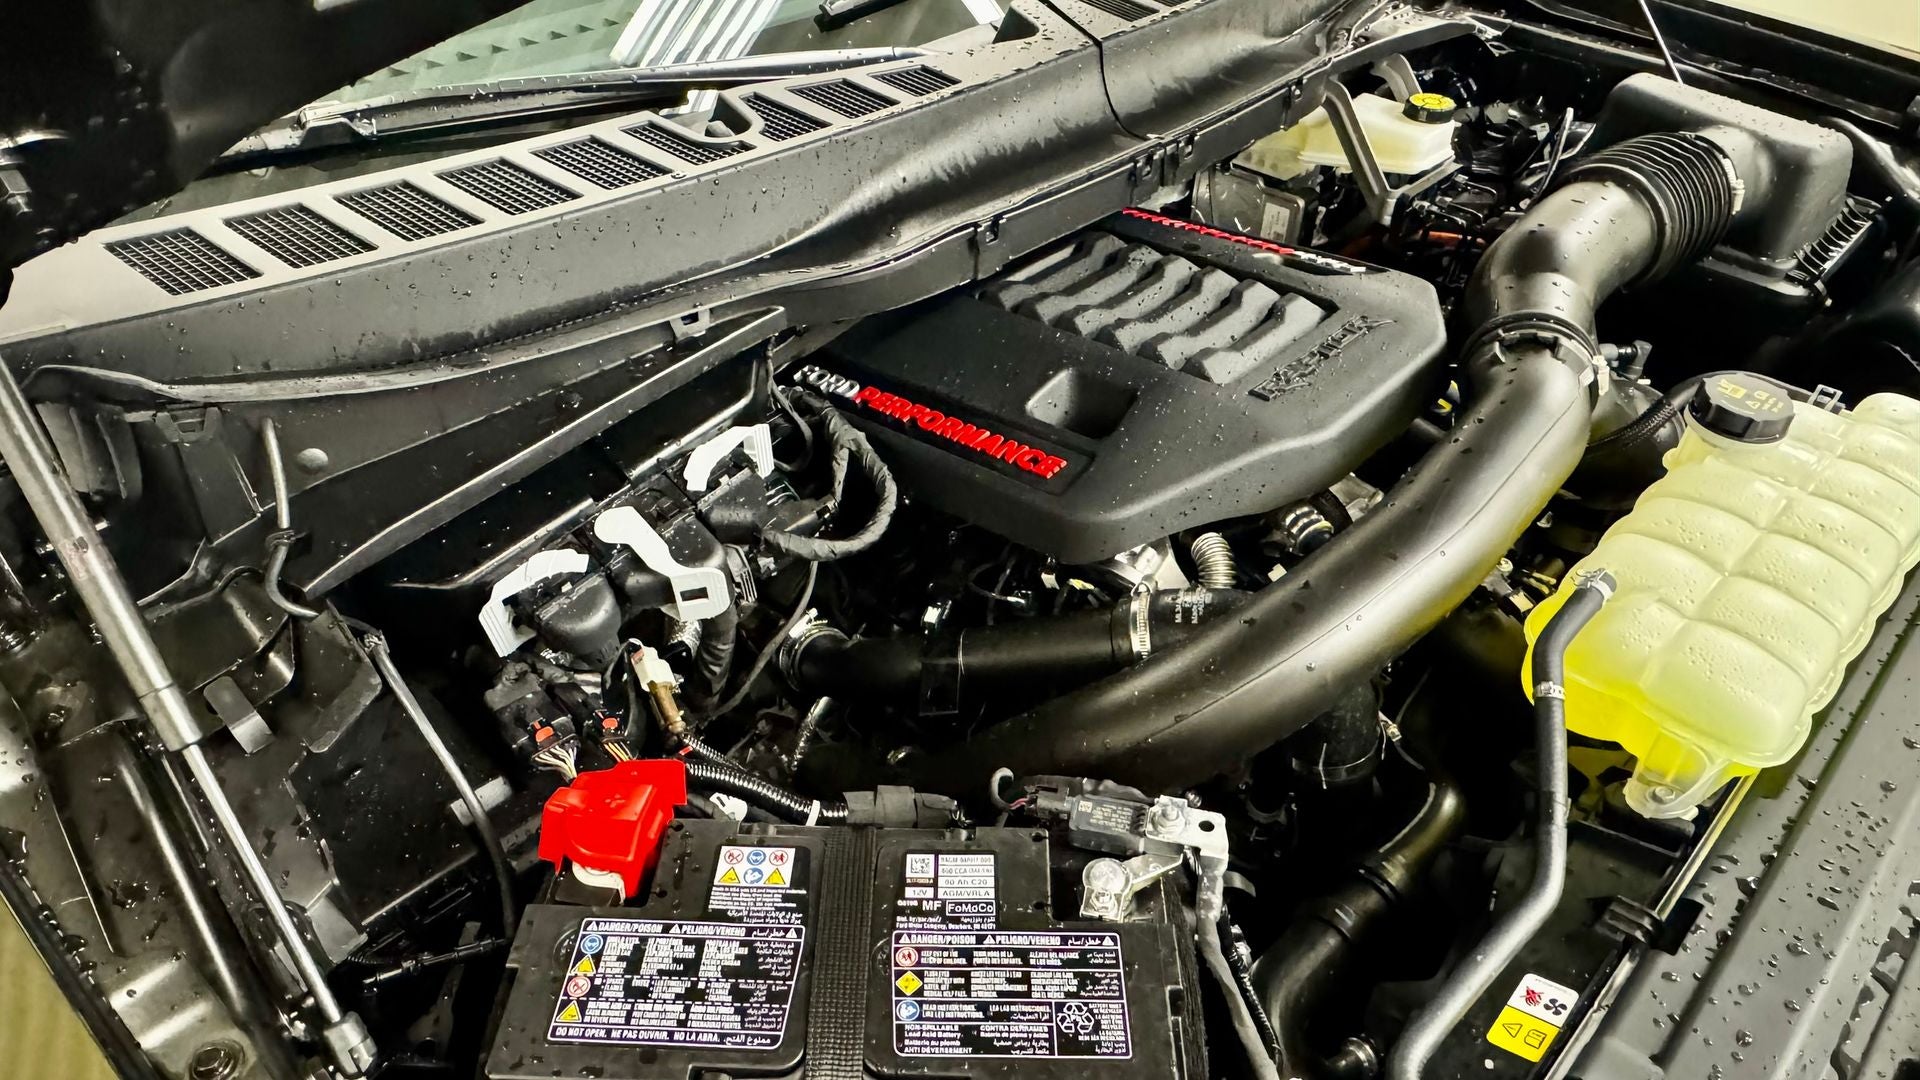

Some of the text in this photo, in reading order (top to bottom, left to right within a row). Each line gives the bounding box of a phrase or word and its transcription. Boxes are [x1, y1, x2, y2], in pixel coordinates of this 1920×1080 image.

[793, 364, 1068, 479] FORD PERFORMANCE
[922, 900, 942, 911] MF
[948, 903, 994, 913] FoMoCo
[599, 922, 663, 933] DANGER/POISON
[681, 926, 746, 937] PELIGRO/VENENO
[910, 934, 976, 945] DANGER/POISON
[996, 935, 1061, 946] PELIGRO/VENENO
[556, 1028, 568, 1036] DO
[568, 1028, 584, 1036] NOT
[585, 1029, 607, 1037] OPEN.
[611, 1030, 622, 1038] NE
[622, 1030, 638, 1038] PAS
[674, 1032, 686, 1040] NO
[686, 1032, 697, 1041] LA
[697, 1033, 720, 1042] ABRA.
[746, 1036, 771, 1045] ممنوع
